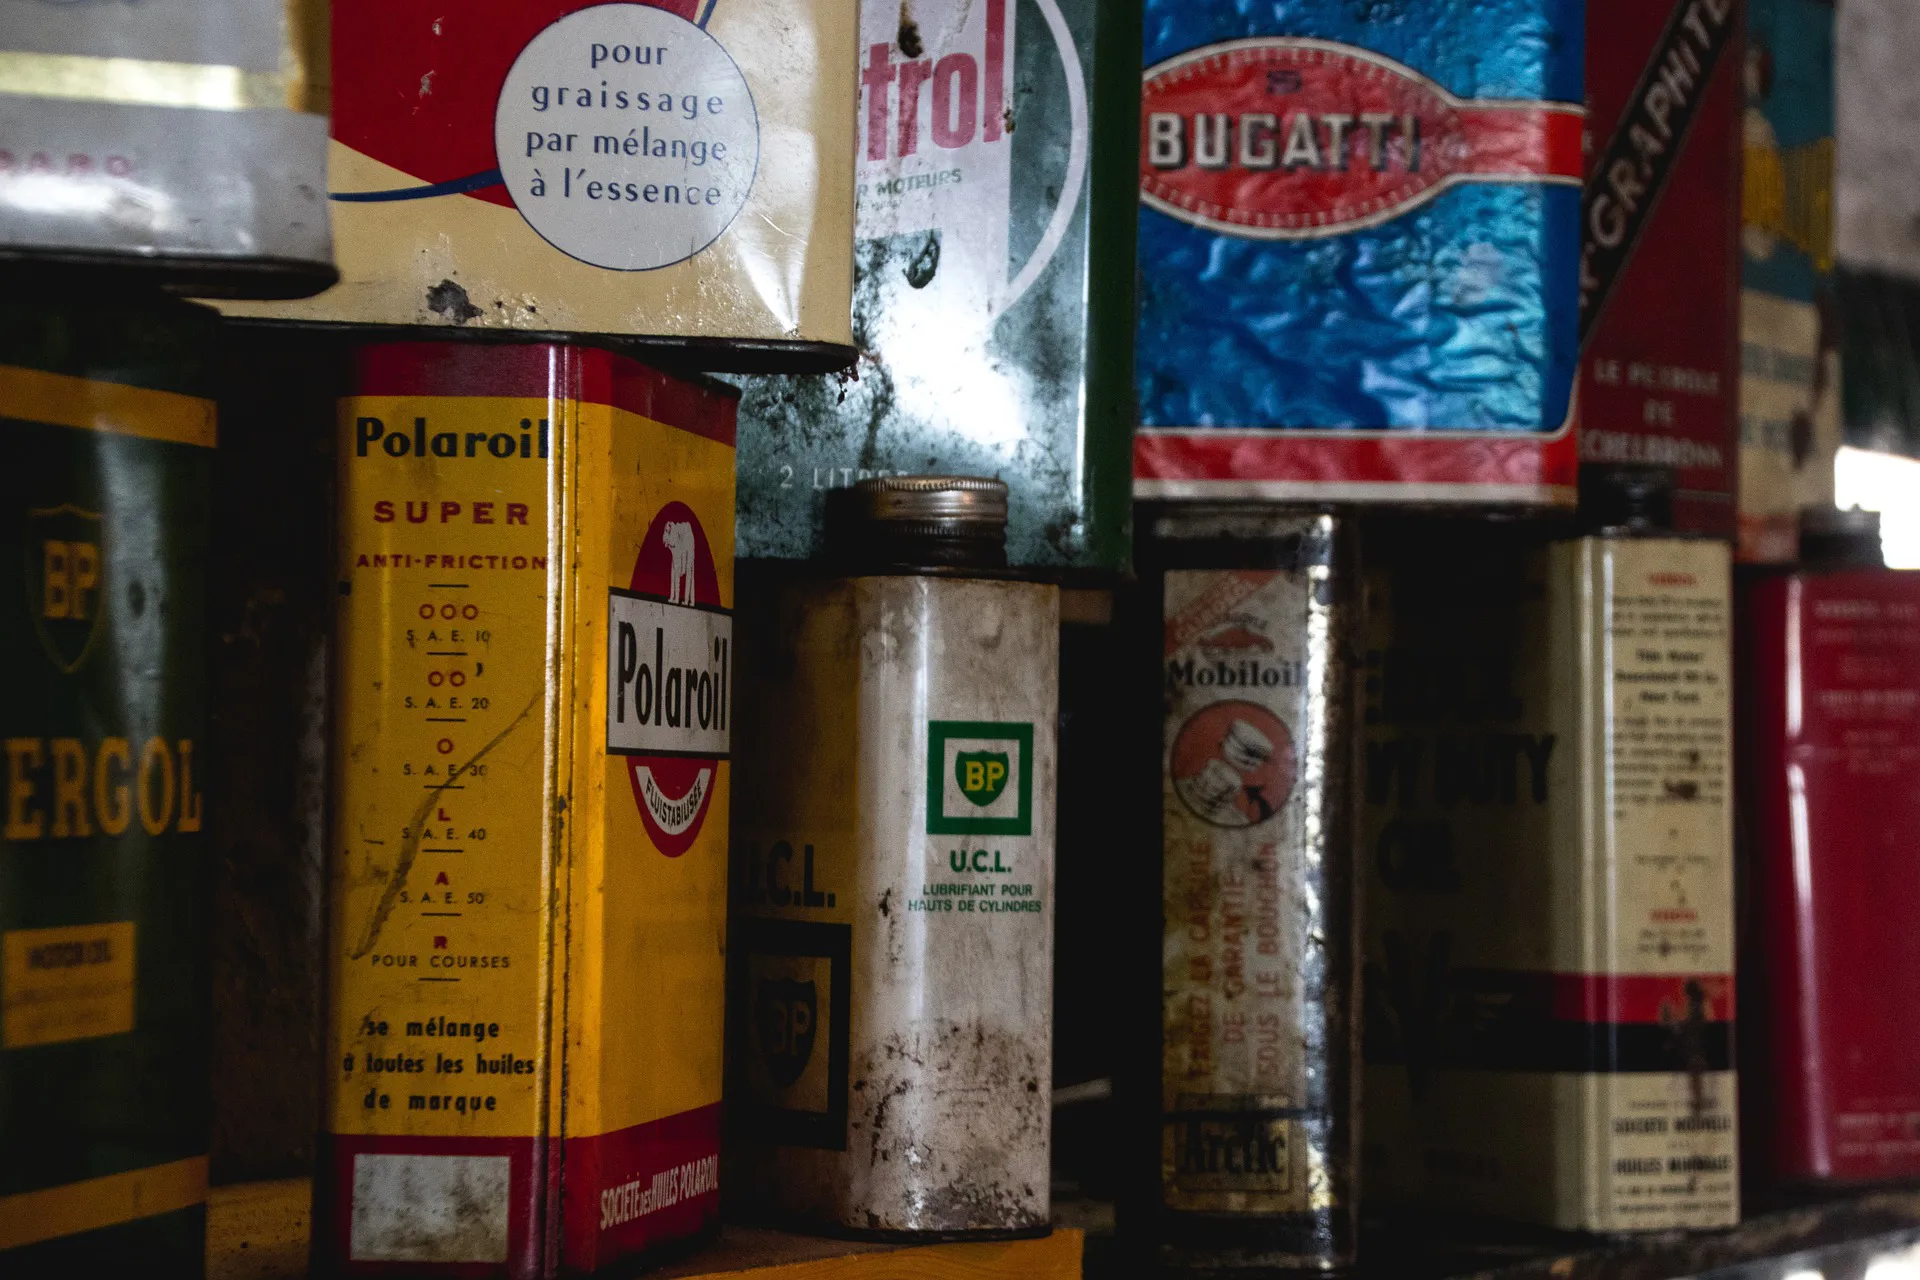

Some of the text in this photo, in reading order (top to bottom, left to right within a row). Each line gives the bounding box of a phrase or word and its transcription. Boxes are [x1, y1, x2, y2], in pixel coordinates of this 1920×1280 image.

[590, 43, 668, 68] pour
[858, 0, 1006, 162] trol
[531, 80, 723, 120] graissage
[526, 126, 728, 165] par mélange
[1148, 112, 1421, 173] BUGATTI
[531, 167, 721, 206] à l'essence
[875, 168, 962, 196] MOTEURS
[356, 416, 549, 458] Polaroil
[780, 464, 909, 491] 2 LIT
[373, 500, 529, 525] SUPER
[356, 553, 547, 570] ANTI-FRICTION
[43, 540, 99, 620] BP
[476, 630, 491, 643] 10
[617, 621, 728, 731] Polaroil
[1166, 659, 1302, 687] Mobiloil
[471, 697, 490, 710] 20
[3, 735, 203, 840] ERGOL
[965, 760, 1005, 792] BP
[437, 807, 451, 822] L
[468, 828, 487, 841] 40
[950, 849, 1012, 873] U.C.L.
[434, 871, 450, 886] A
[922, 883, 1033, 897] LUBRIFIANT POUR
[467, 892, 485, 905] 50
[908, 899, 1042, 913] HAUTS DE CYLINDRES
[433, 935, 448, 950] R
[371, 954, 511, 969] POUR COURSES
[1220, 871, 1245, 1044] DE GARANTIE
[1256, 971, 1281, 998] LE
[366, 1016, 500, 1042] se mélange
[1256, 1013, 1280, 1076] SOUS
[366, 1053, 425, 1073] toutes
[436, 1053, 464, 1074] les
[476, 1053, 535, 1075] huiles
[364, 1088, 497, 1115] de marque
[652, 1166, 679, 1212] HUILES
[679, 1153, 718, 1201] POLAROIL
